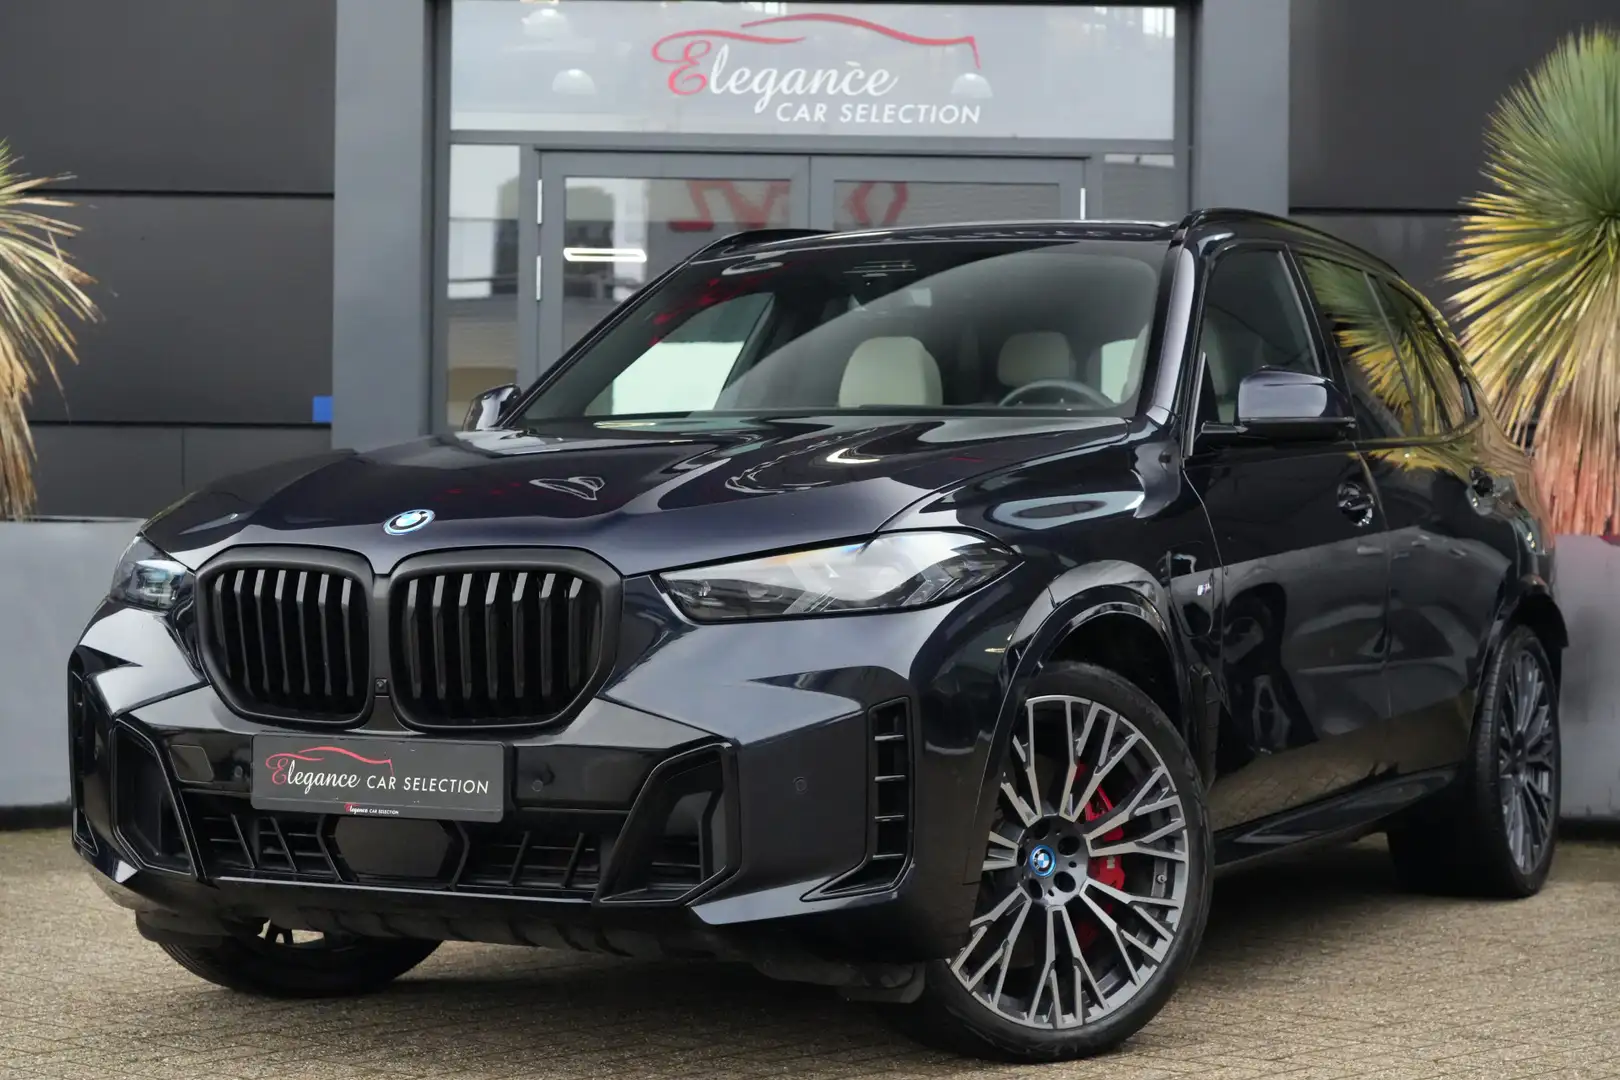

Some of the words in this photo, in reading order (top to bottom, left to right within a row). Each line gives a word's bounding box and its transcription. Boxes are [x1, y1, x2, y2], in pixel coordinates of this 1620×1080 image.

[776, 102, 828, 123] CAR
[839, 104, 981, 124] SELECTION
[265, 753, 361, 795] Elegance
[366, 775, 396, 790] CAR
[403, 777, 489, 794] SELECTION
